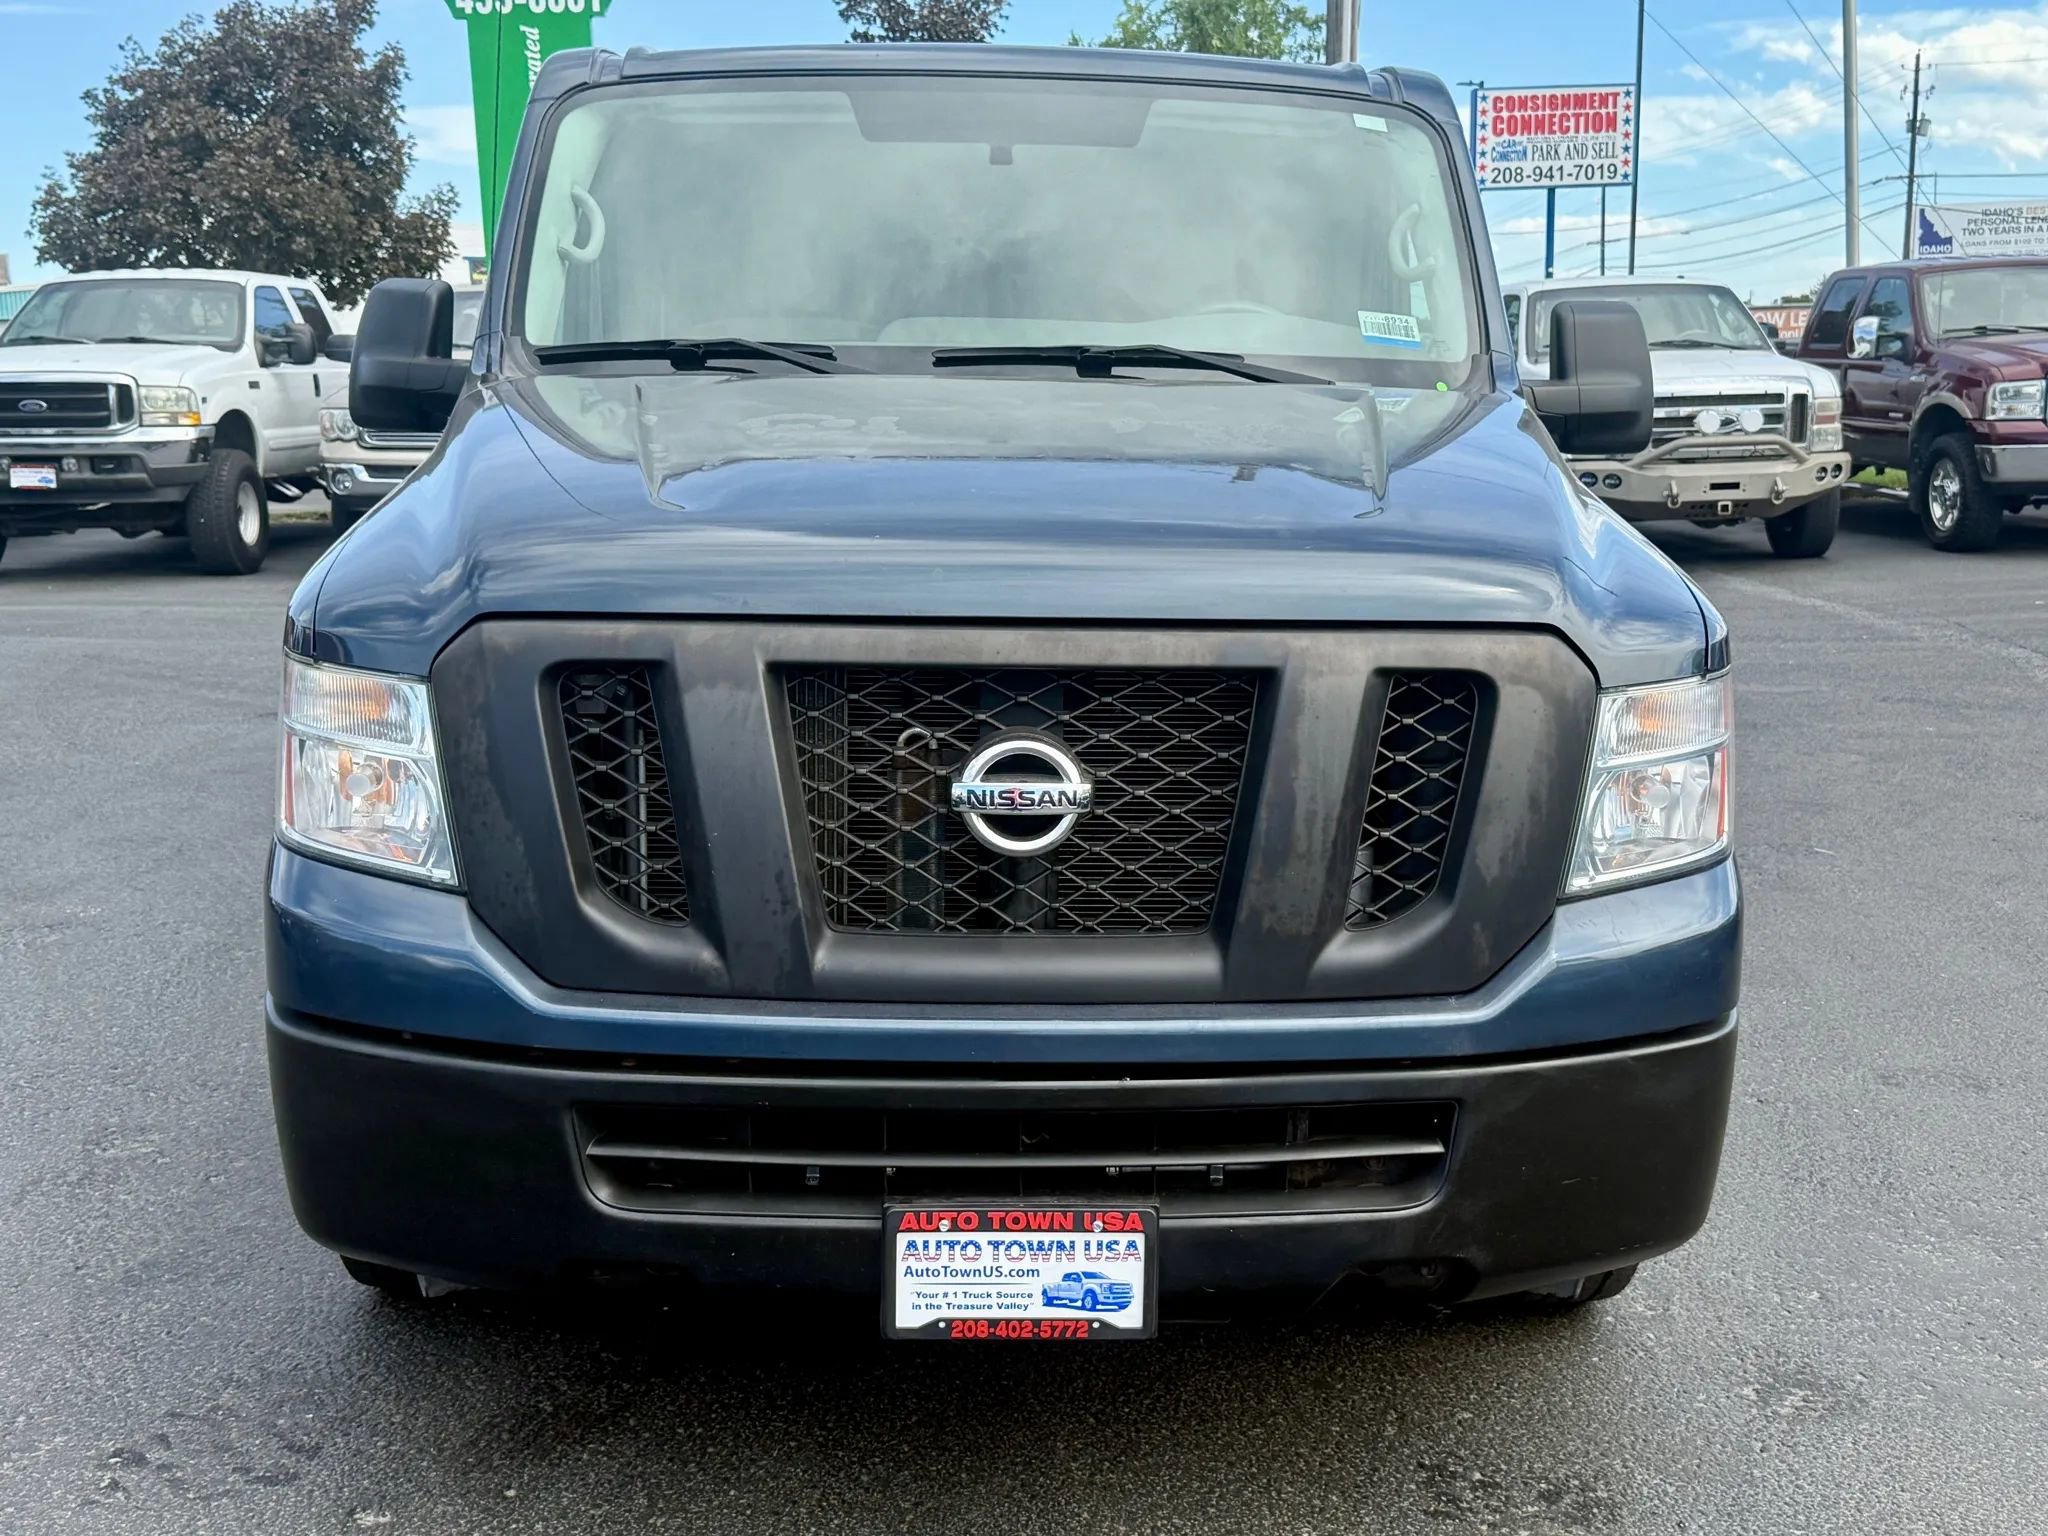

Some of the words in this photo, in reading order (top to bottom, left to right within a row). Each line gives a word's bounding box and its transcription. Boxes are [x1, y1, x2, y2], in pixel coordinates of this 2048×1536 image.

[1492, 91, 1620, 114] CONSIGNMENT
[1491, 111, 1618, 137] CONNECTION
[1531, 143, 1562, 161] PARK
[1564, 142, 1589, 160] AND
[1591, 142, 1618, 159] SELL
[1490, 163, 1619, 184] 208-941-7019
[1981, 207, 2024, 217] IDAHO'S
[1967, 216, 2022, 226] PERSONAL
[1962, 227, 1986, 236] TWO
[1988, 225, 2022, 235] YEARS
[2023, 224, 2035, 234] IN
[2036, 224, 2046, 233] A
[1919, 243, 1952, 254] IDAHO
[1989, 238, 2012, 246] FROM
[1754, 311, 1786, 328] OW
[1789, 311, 1808, 328] LE
[966, 788, 1078, 808] NISSAN
[899, 1211, 980, 1231] AUTO
[987, 1211, 1074, 1231] TOWN
[1083, 1211, 1145, 1232] USA
[901, 1239, 983, 1263] AUTO
[987, 1239, 1076, 1263] TOWN
[1083, 1239, 1142, 1263] USA
[903, 1265, 1041, 1278] AutoTownUS.com
[942, 1291, 949, 1299] #
[952, 1291, 958, 1299] 1
[961, 1291, 993, 1299] Truck
[995, 1291, 1034, 1299] Source
[911, 1302, 922, 1310] in
[924, 1302, 943, 1310] the
[945, 1302, 994, 1310] Treasure
[950, 1319, 1090, 1339] 208-402-5772
